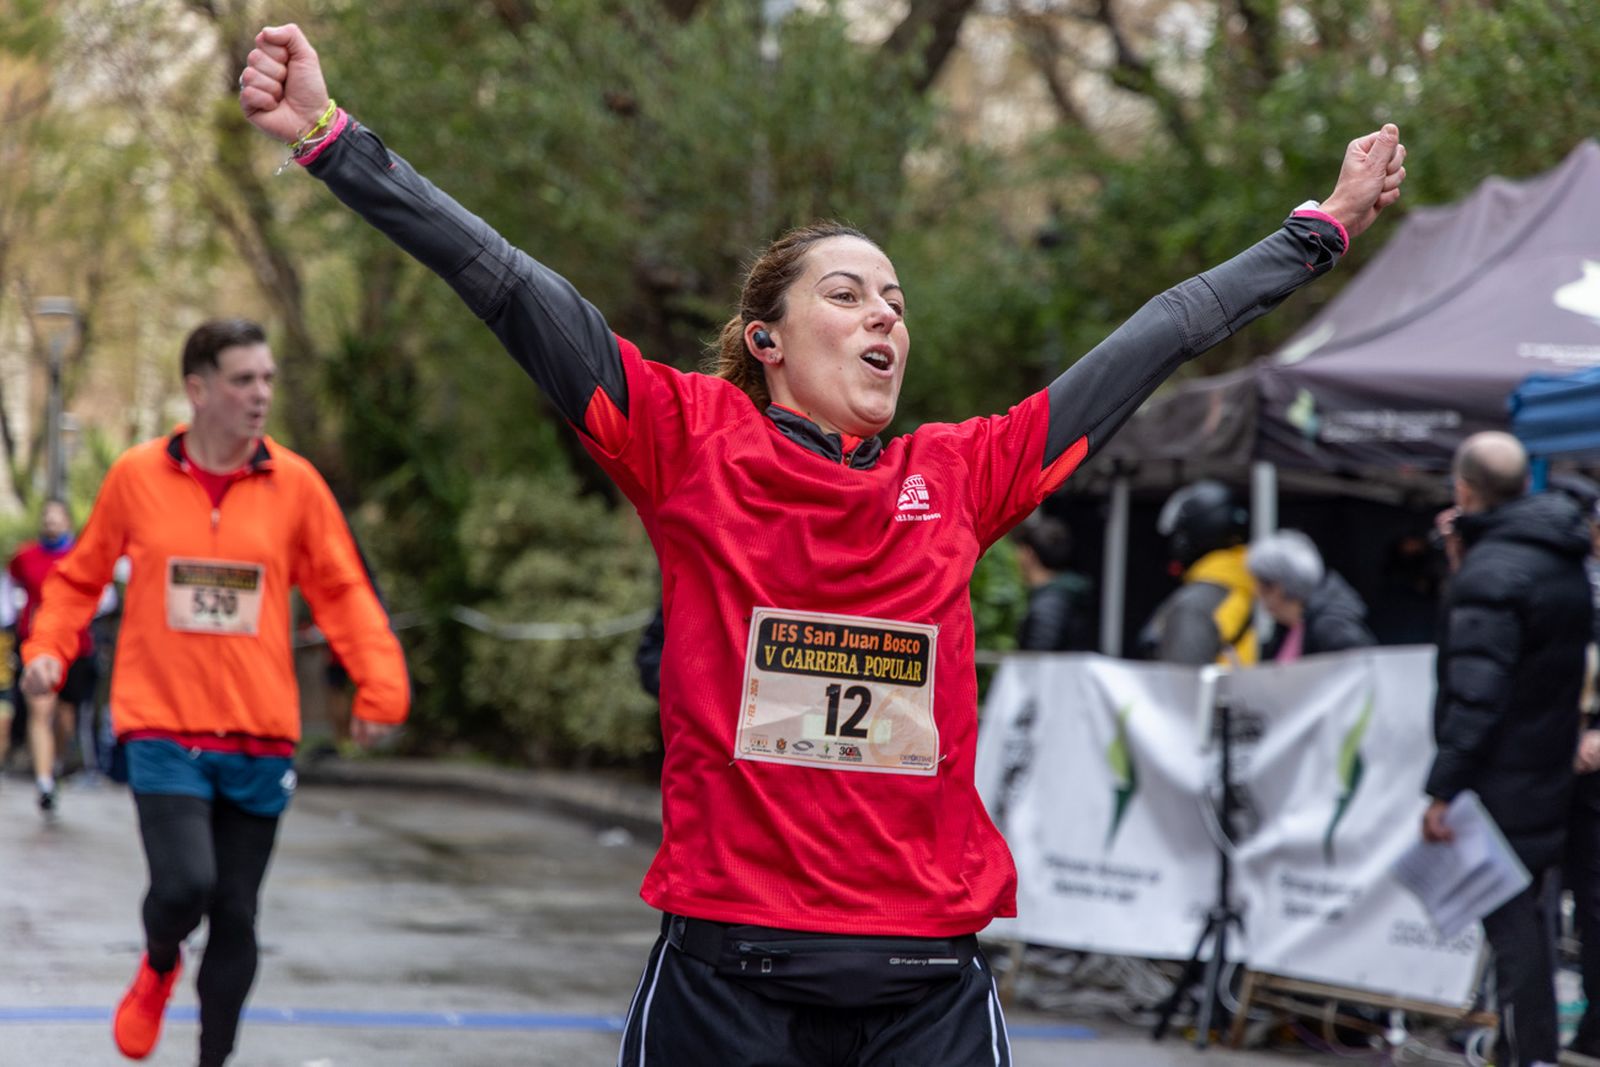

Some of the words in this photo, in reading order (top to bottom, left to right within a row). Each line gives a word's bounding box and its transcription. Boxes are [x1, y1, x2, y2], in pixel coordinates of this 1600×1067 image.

[192, 586, 239, 618] 520
[771, 623, 799, 643] IES
[803, 626, 836, 647] San
[840, 629, 880, 651] Juan
[883, 633, 921, 655] Bosco
[764, 645, 777, 667] V
[781, 647, 859, 675] CARRERA
[864, 655, 922, 682] POPULAR
[824, 683, 872, 739] 12
